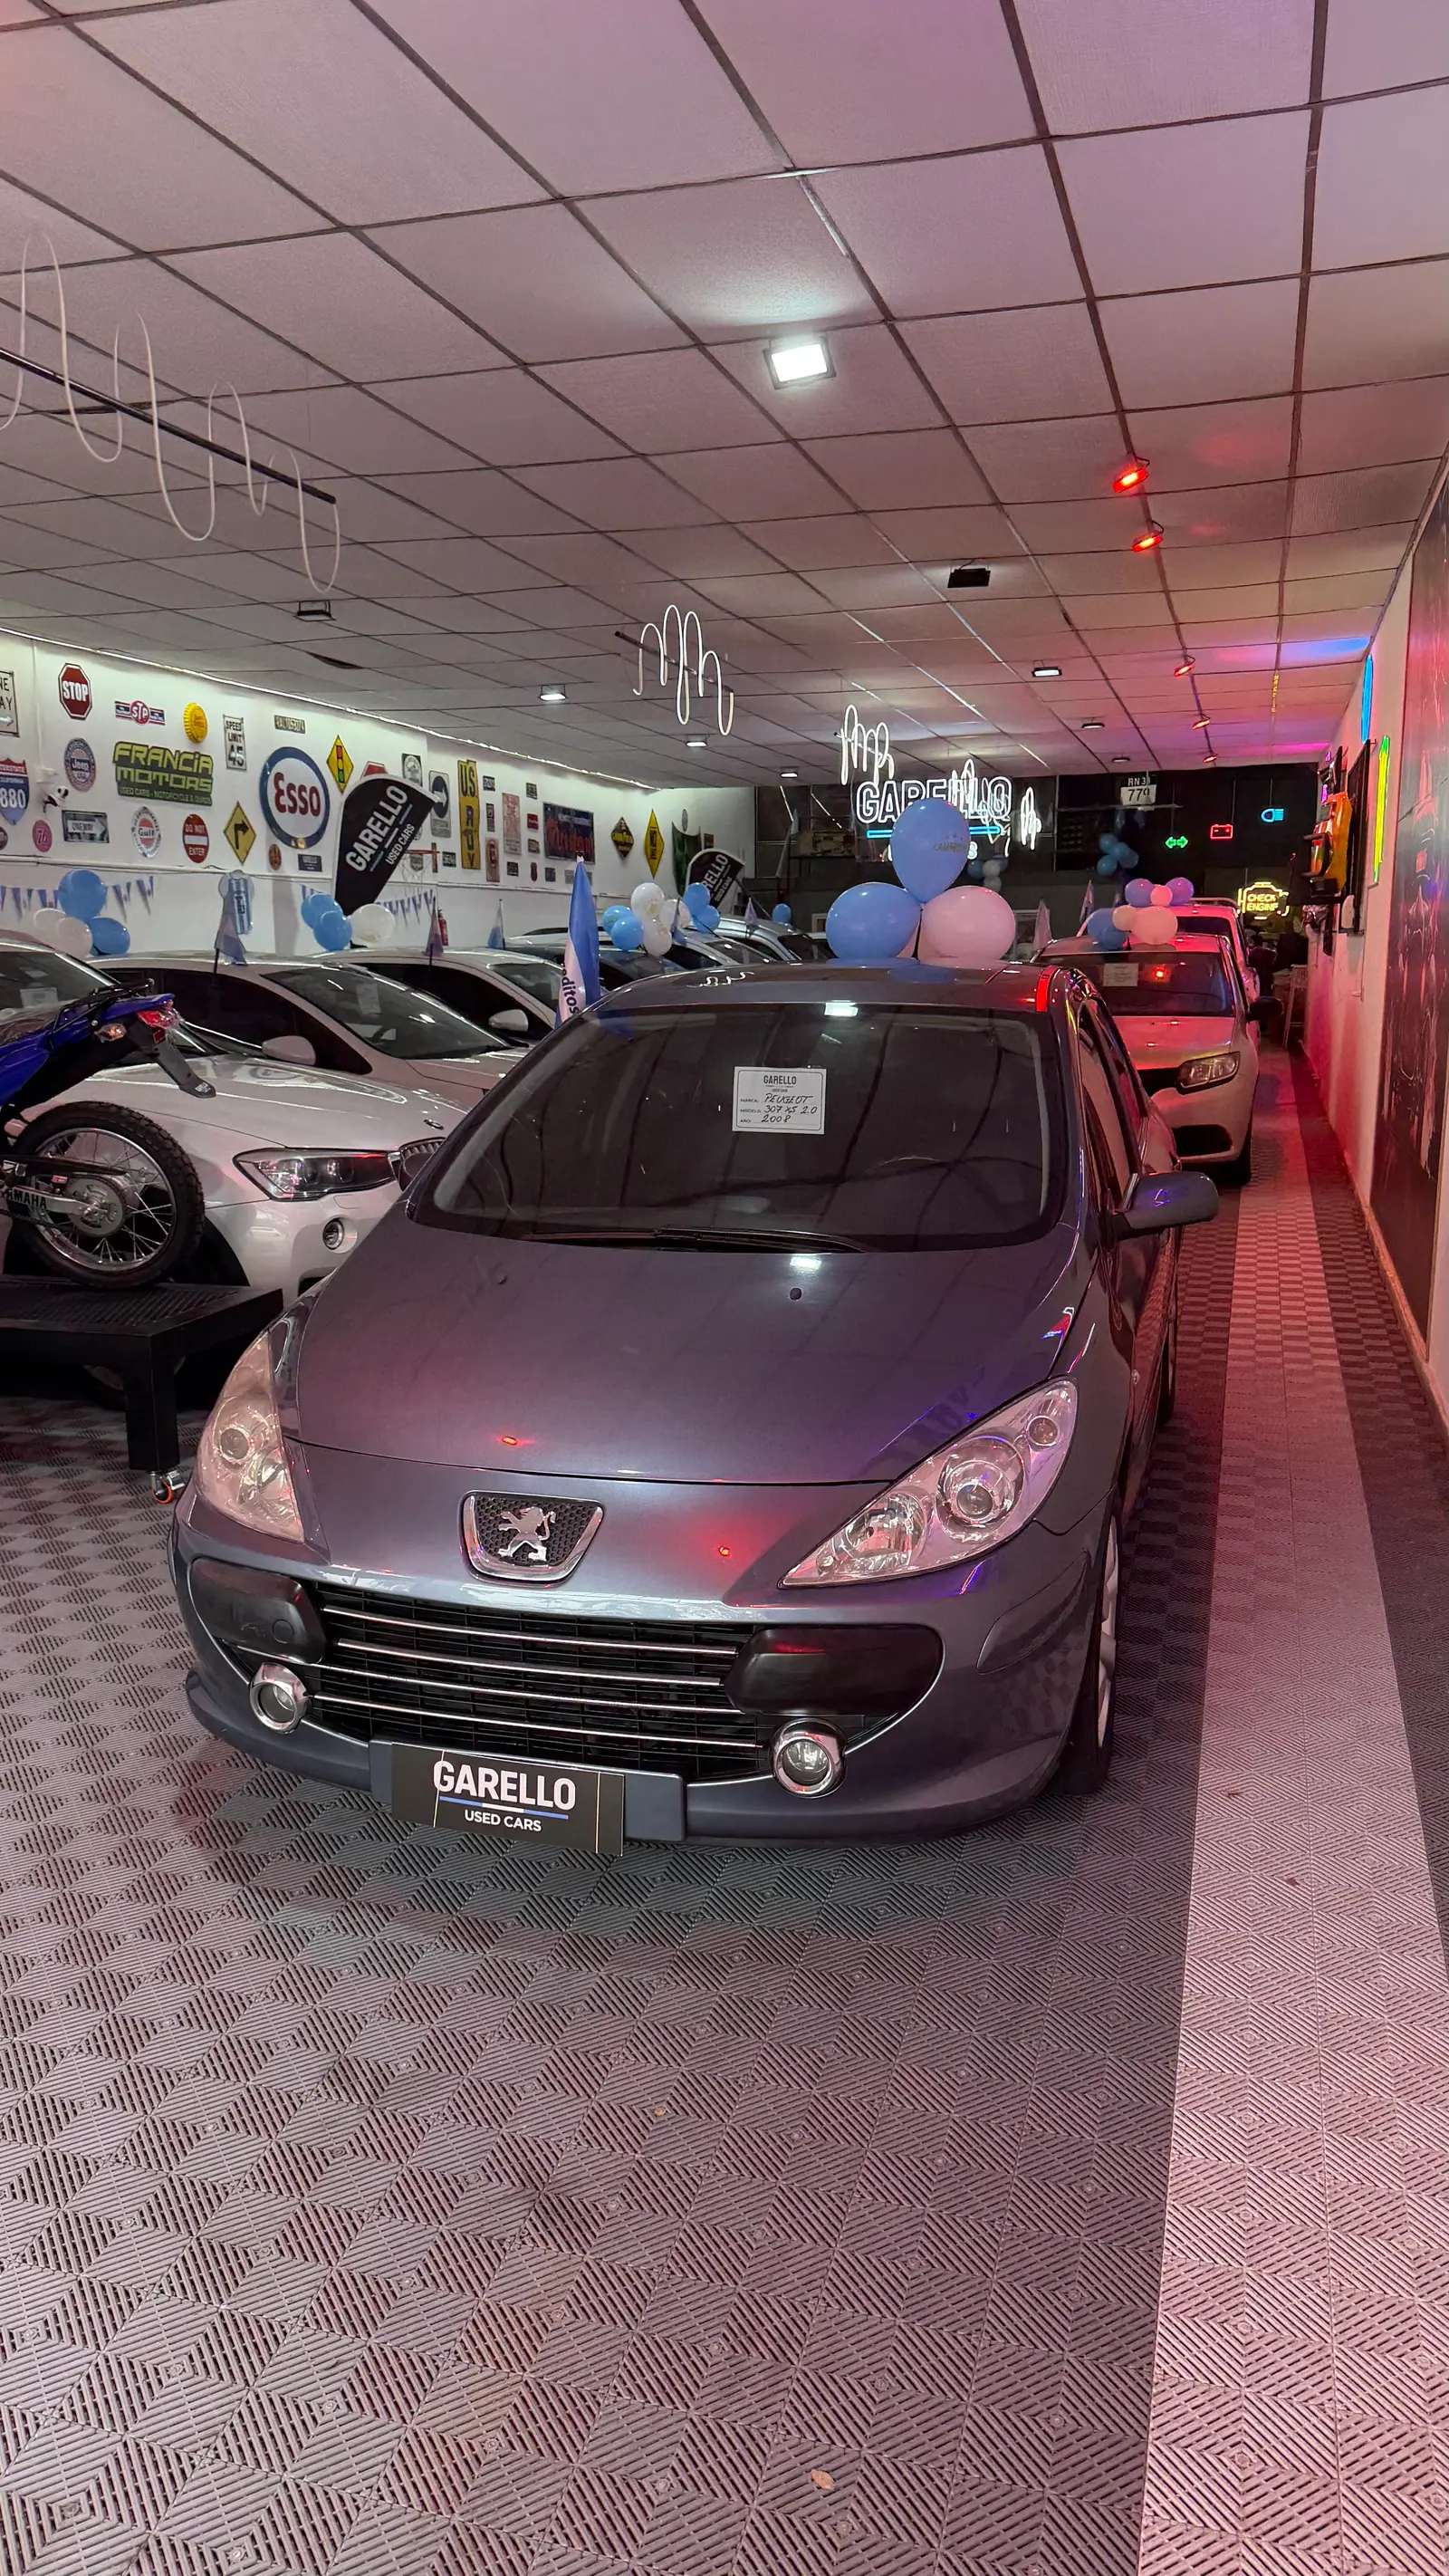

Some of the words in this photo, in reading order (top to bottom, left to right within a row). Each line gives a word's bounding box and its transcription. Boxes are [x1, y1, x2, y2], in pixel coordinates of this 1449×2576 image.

[0, 678, 10, 692] NE
[62, 680, 89, 702] STOP
[0, 695, 13, 711] AY
[131, 702, 149, 720] STP
[226, 720, 242, 732] SPEED
[227, 732, 243, 743] LIMIT
[227, 745, 245, 766] 45
[72, 759, 90, 773] Jeep
[116, 766, 213, 793] MOTORS
[1128, 777, 1140, 786] RN
[138, 827, 155, 837] Gulf
[185, 823, 193, 832] DO
[345, 785, 408, 871] GARELLO
[385, 842, 401, 865] USED
[398, 823, 415, 845] CARS
[188, 847, 205, 856] ENTER
[701, 853, 729, 889] RELLO
[1247, 893, 1277, 902] CHECK
[763, 1075, 797, 1085] GARELLO
[764, 1092, 813, 1104] PEUGEOT
[763, 1104, 783, 1113] 307
[800, 1105, 818, 1114] 2.0
[761, 1114, 792, 1123] 2008
[8, 1187, 47, 1209] AMAHA
[433, 1760, 577, 1811] GARELLO
[465, 1809, 501, 1826] USED
[504, 1814, 542, 1832] CARS
